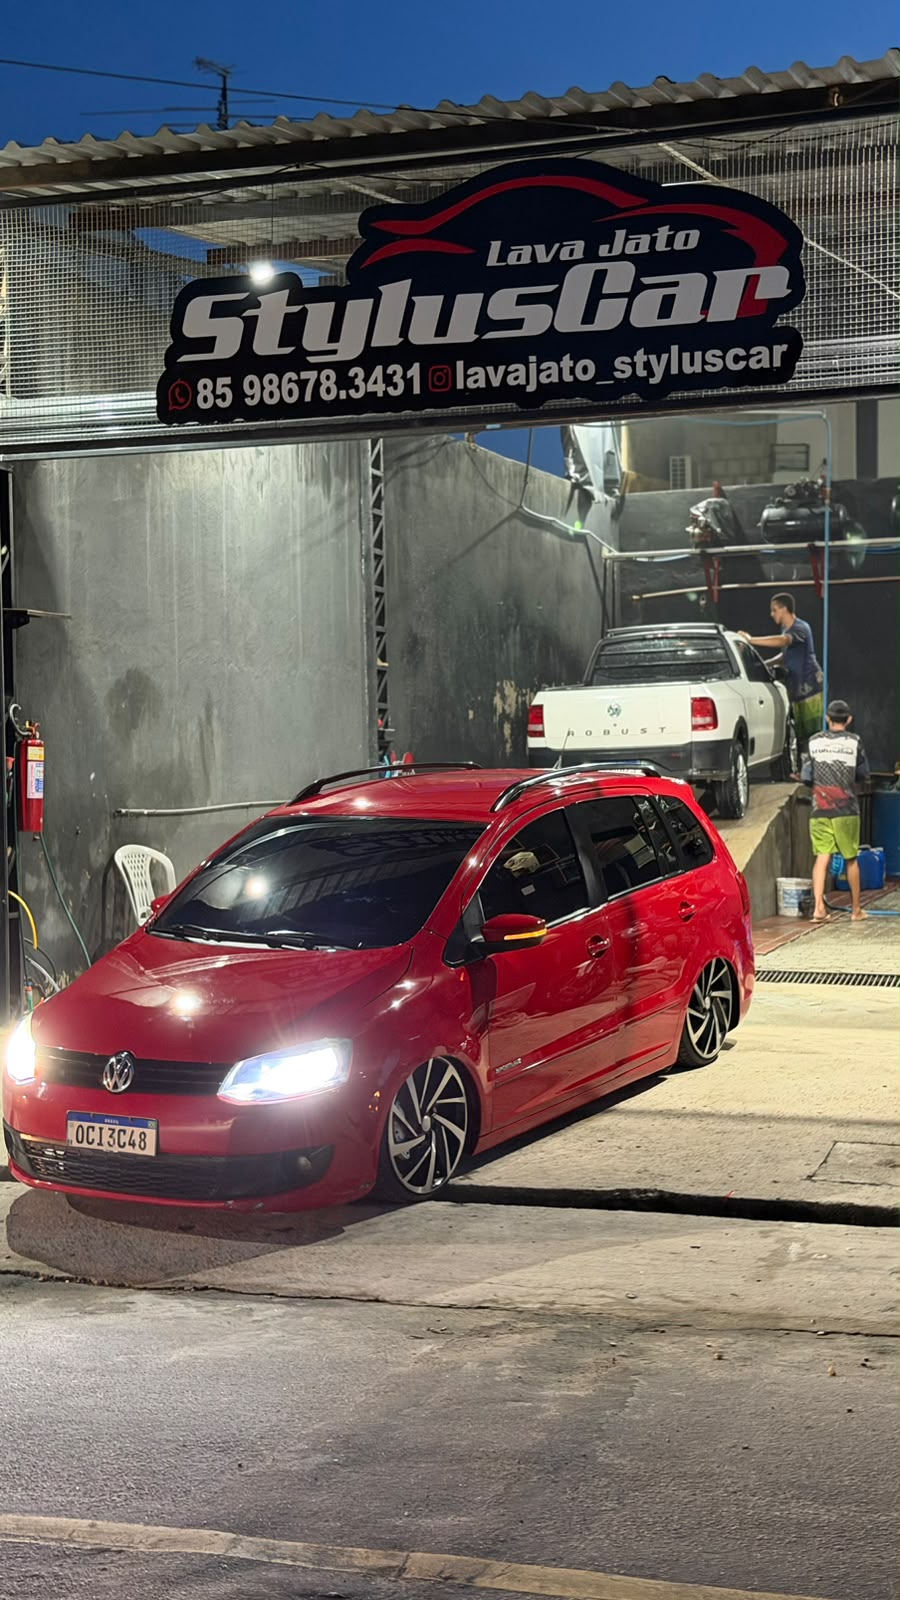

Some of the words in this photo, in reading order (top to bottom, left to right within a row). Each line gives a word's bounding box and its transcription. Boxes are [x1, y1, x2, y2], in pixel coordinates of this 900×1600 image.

[486, 240, 585, 267] Lava
[599, 225, 701, 257] Jato
[176, 261, 792, 363] StylusCar
[196, 377, 233, 409] 85
[243, 362, 421, 406] 98678.3431
[455, 344, 788, 393] lavajato_styluscar
[567, 727, 667, 737] ROBUST
[75, 1124, 147, 1151] OCI3C48
